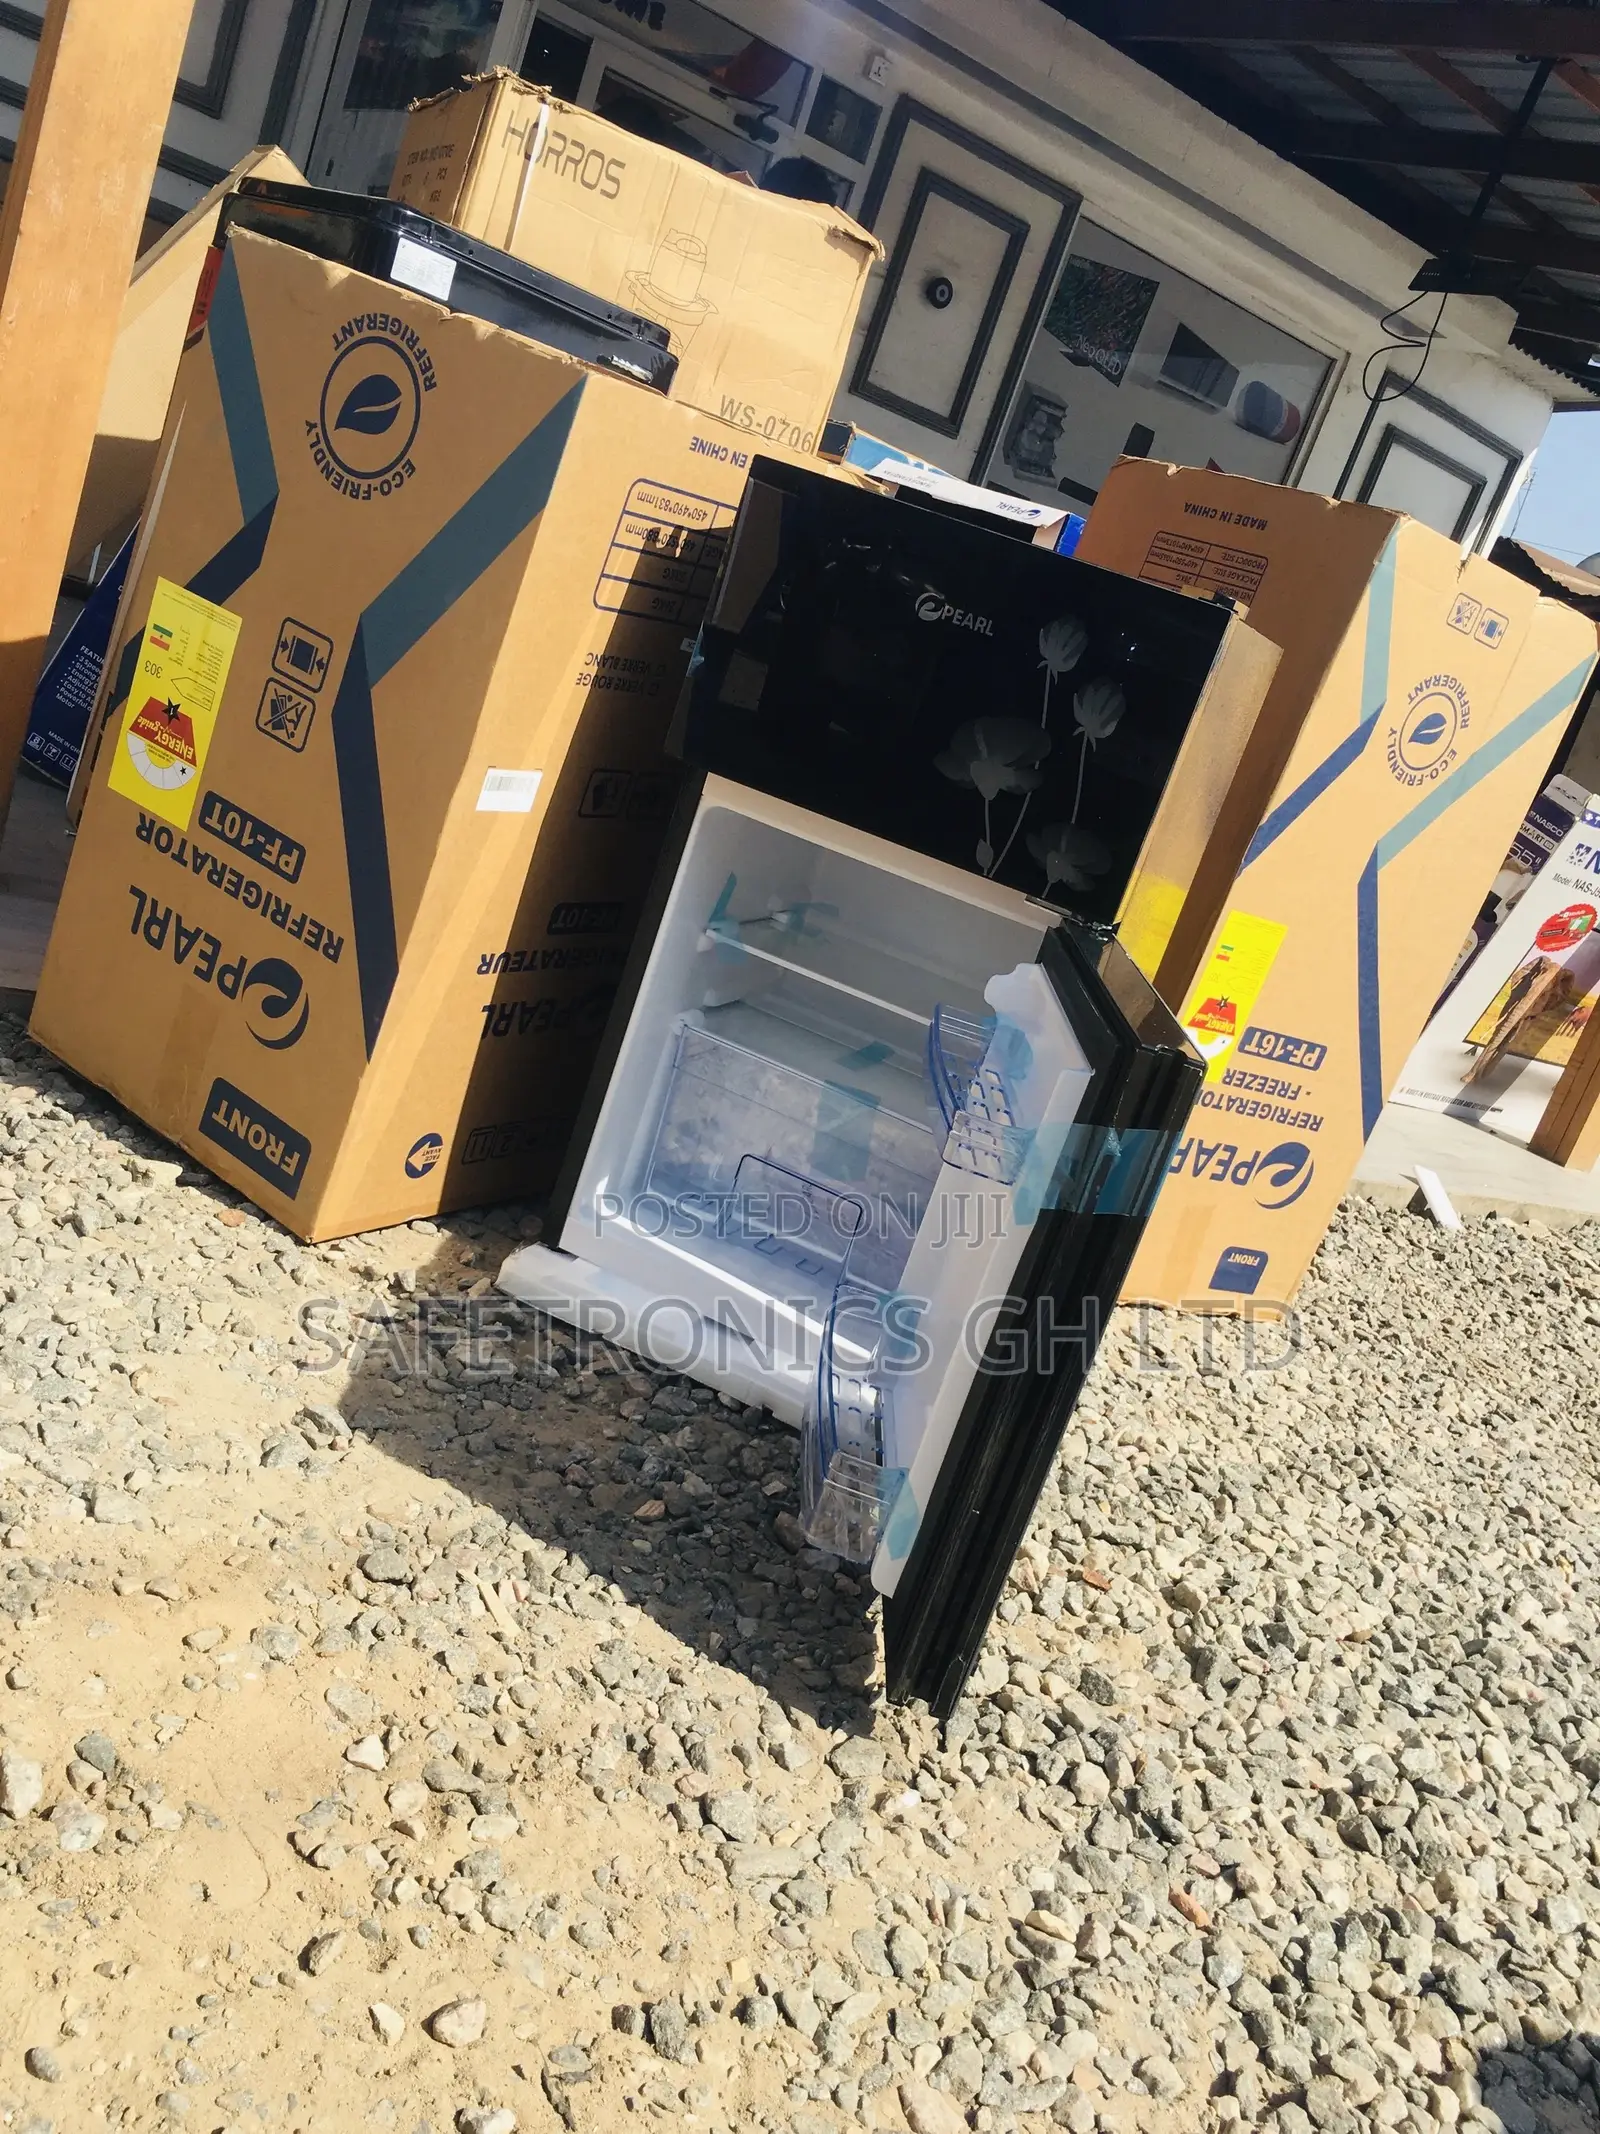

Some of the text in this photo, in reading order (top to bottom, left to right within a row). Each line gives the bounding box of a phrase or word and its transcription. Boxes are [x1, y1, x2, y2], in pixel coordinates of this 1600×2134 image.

[500, 110, 627, 200] HORROS
[332, 313, 437, 391] REFRIGERANT
[719, 394, 814, 453] WS-0706
[305, 420, 417, 500] ECO-FRIENDLY
[689, 436, 748, 468] EN CHINE
[996, 500, 1026, 515] PEARL
[1183, 502, 1268, 531] MADE IN CHINA
[1238, 556, 1265, 571] PRODUCT
[1226, 570, 1258, 586] PACKAGE
[941, 603, 994, 637] PEARL
[74, 662, 97, 681] Strong
[144, 660, 163, 679] 303
[584, 652, 619, 671] BLANC
[63, 680, 79, 694] Easy
[71, 668, 93, 688] Energy
[575, 672, 614, 690] ROUGE
[55, 693, 76, 709] Motor
[60, 687, 87, 711] Powerful
[1407, 674, 1471, 730] REFRIGERANT
[137, 716, 161, 733] guide
[48, 731, 64, 744] MADE
[153, 730, 194, 760] ENERGY
[1387, 727, 1458, 786] ECO-FRIENDLY
[1519, 823, 1544, 844] SMART
[1533, 812, 1564, 837] NASCO
[205, 802, 300, 877] PF-10T
[135, 812, 344, 964] REFRIGERATOR
[128, 884, 248, 1000] PEARL
[1244, 1031, 1322, 1067] PF-16T
[1221, 1067, 1302, 1101] FREEZER
[211, 1100, 300, 1177] FRONT
[421, 1148, 442, 1157] AVANT
[1227, 1252, 1260, 1267] FRONT
